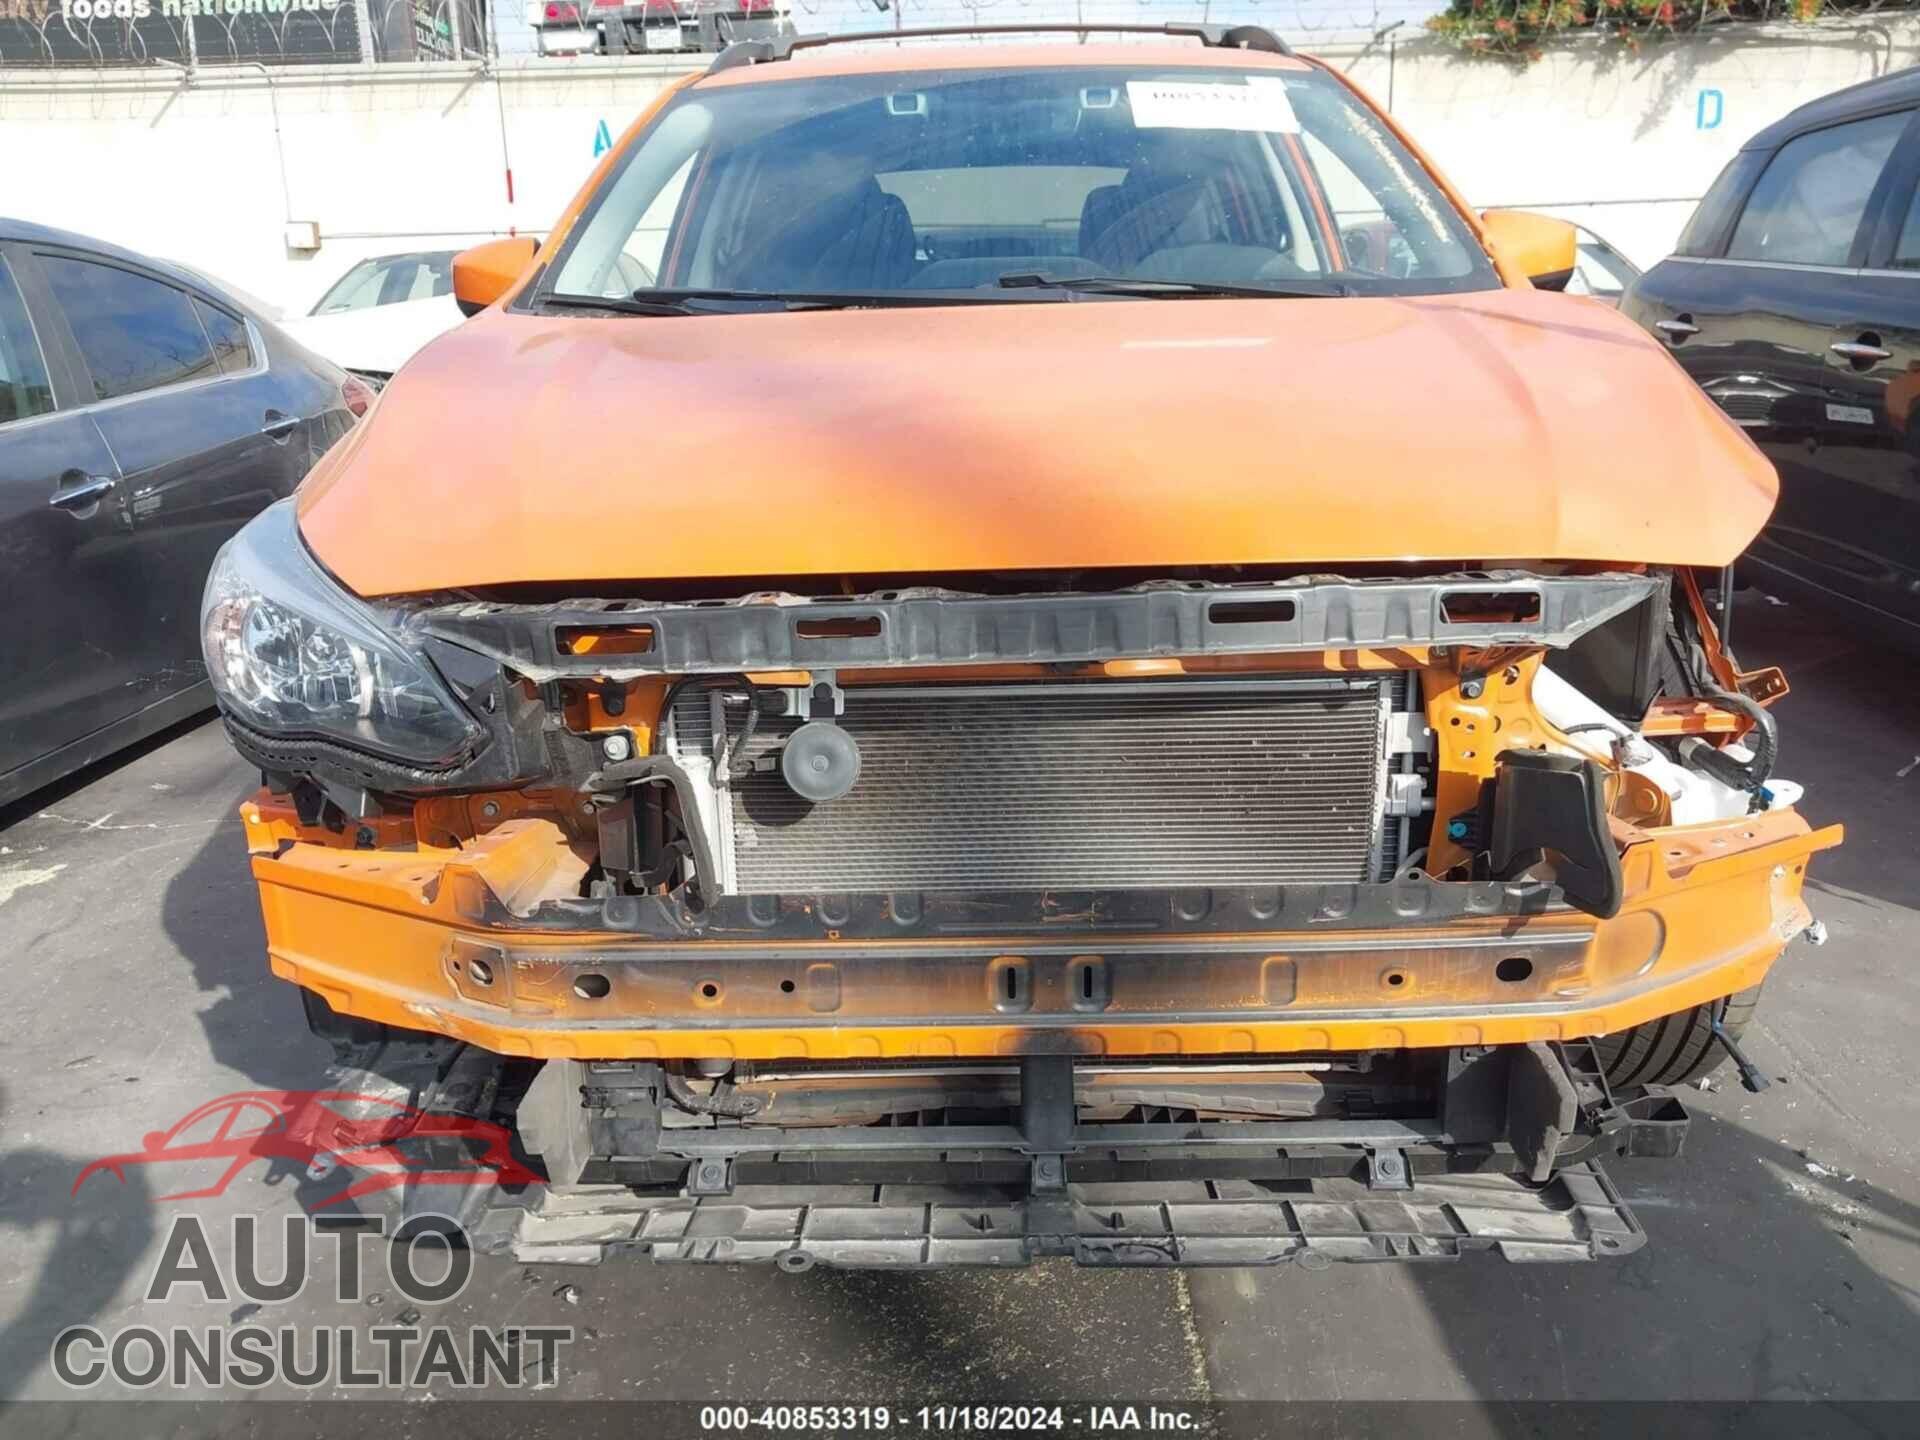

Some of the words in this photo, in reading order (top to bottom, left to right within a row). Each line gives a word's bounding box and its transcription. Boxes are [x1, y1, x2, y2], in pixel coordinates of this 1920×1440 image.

[59, 0, 151, 19] foods
[1697, 90, 1723, 129] D
[593, 119, 612, 158] A
